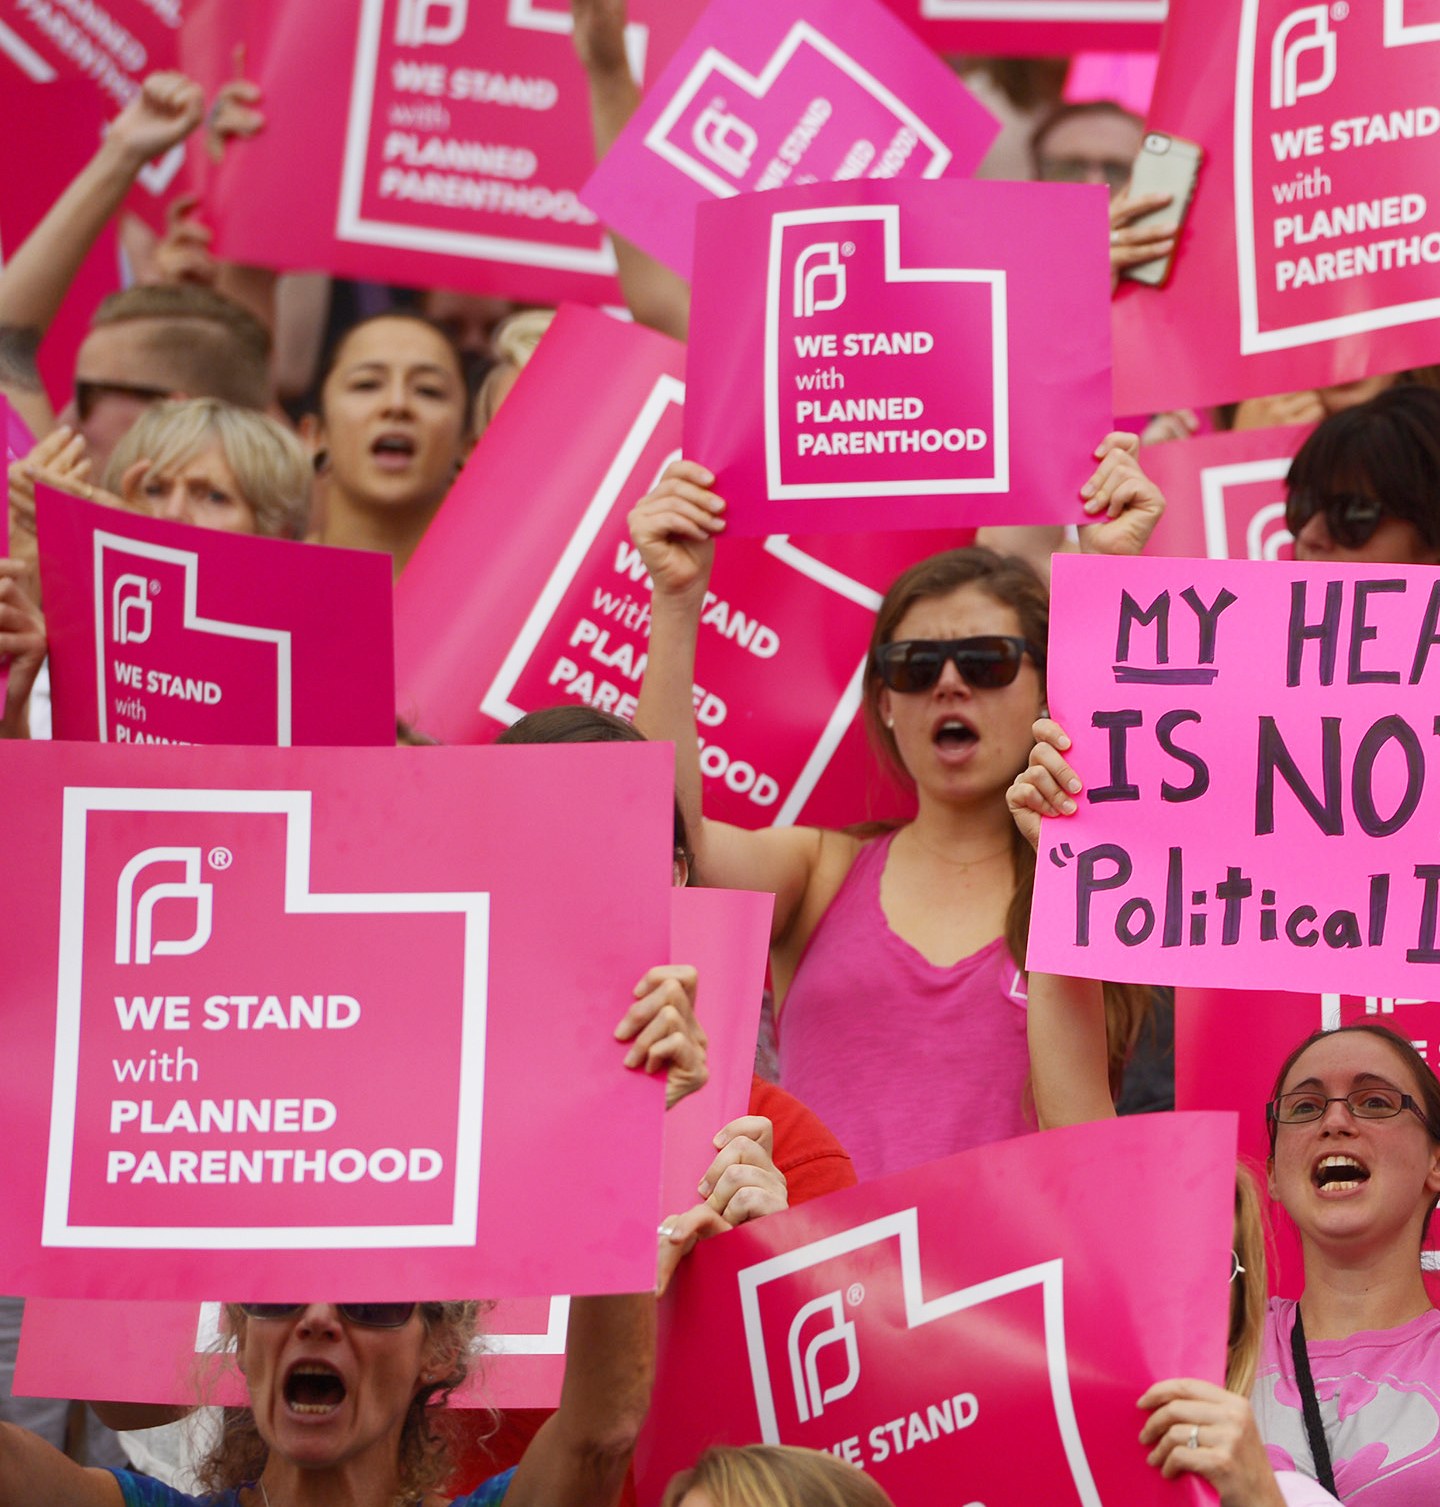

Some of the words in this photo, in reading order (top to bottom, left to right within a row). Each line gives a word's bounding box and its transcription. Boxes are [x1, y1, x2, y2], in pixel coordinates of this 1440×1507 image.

[392, 60, 447, 97] WE
[449, 68, 558, 111] STAND
[383, 131, 538, 180] PLANNED
[1271, 124, 1324, 162] WE
[1272, 166, 1331, 204] with
[1273, 193, 1427, 248] PLANNED
[794, 334, 837, 358] WE
[843, 331, 934, 356] STAND
[795, 366, 844, 390] with
[796, 397, 924, 423] PLANNED
[797, 428, 987, 456] PARENTHOOD
[614, 540, 655, 589] W
[700, 591, 780, 659] TAND
[1114, 585, 1238, 668] MY
[114, 660, 142, 689] WE
[147, 670, 222, 705] STAND
[115, 697, 146, 722] with
[116, 724, 203, 745] PLAN
[549, 656, 780, 806] PAREOOD
[1087, 709, 1209, 804] IS
[114, 996, 190, 1029] WE
[202, 994, 361, 1030] STAND
[112, 1047, 199, 1084] with
[110, 1098, 337, 1133] PLANNED
[106, 1148, 443, 1184] PARENTHOOD
[868, 1392, 979, 1462] STAND
